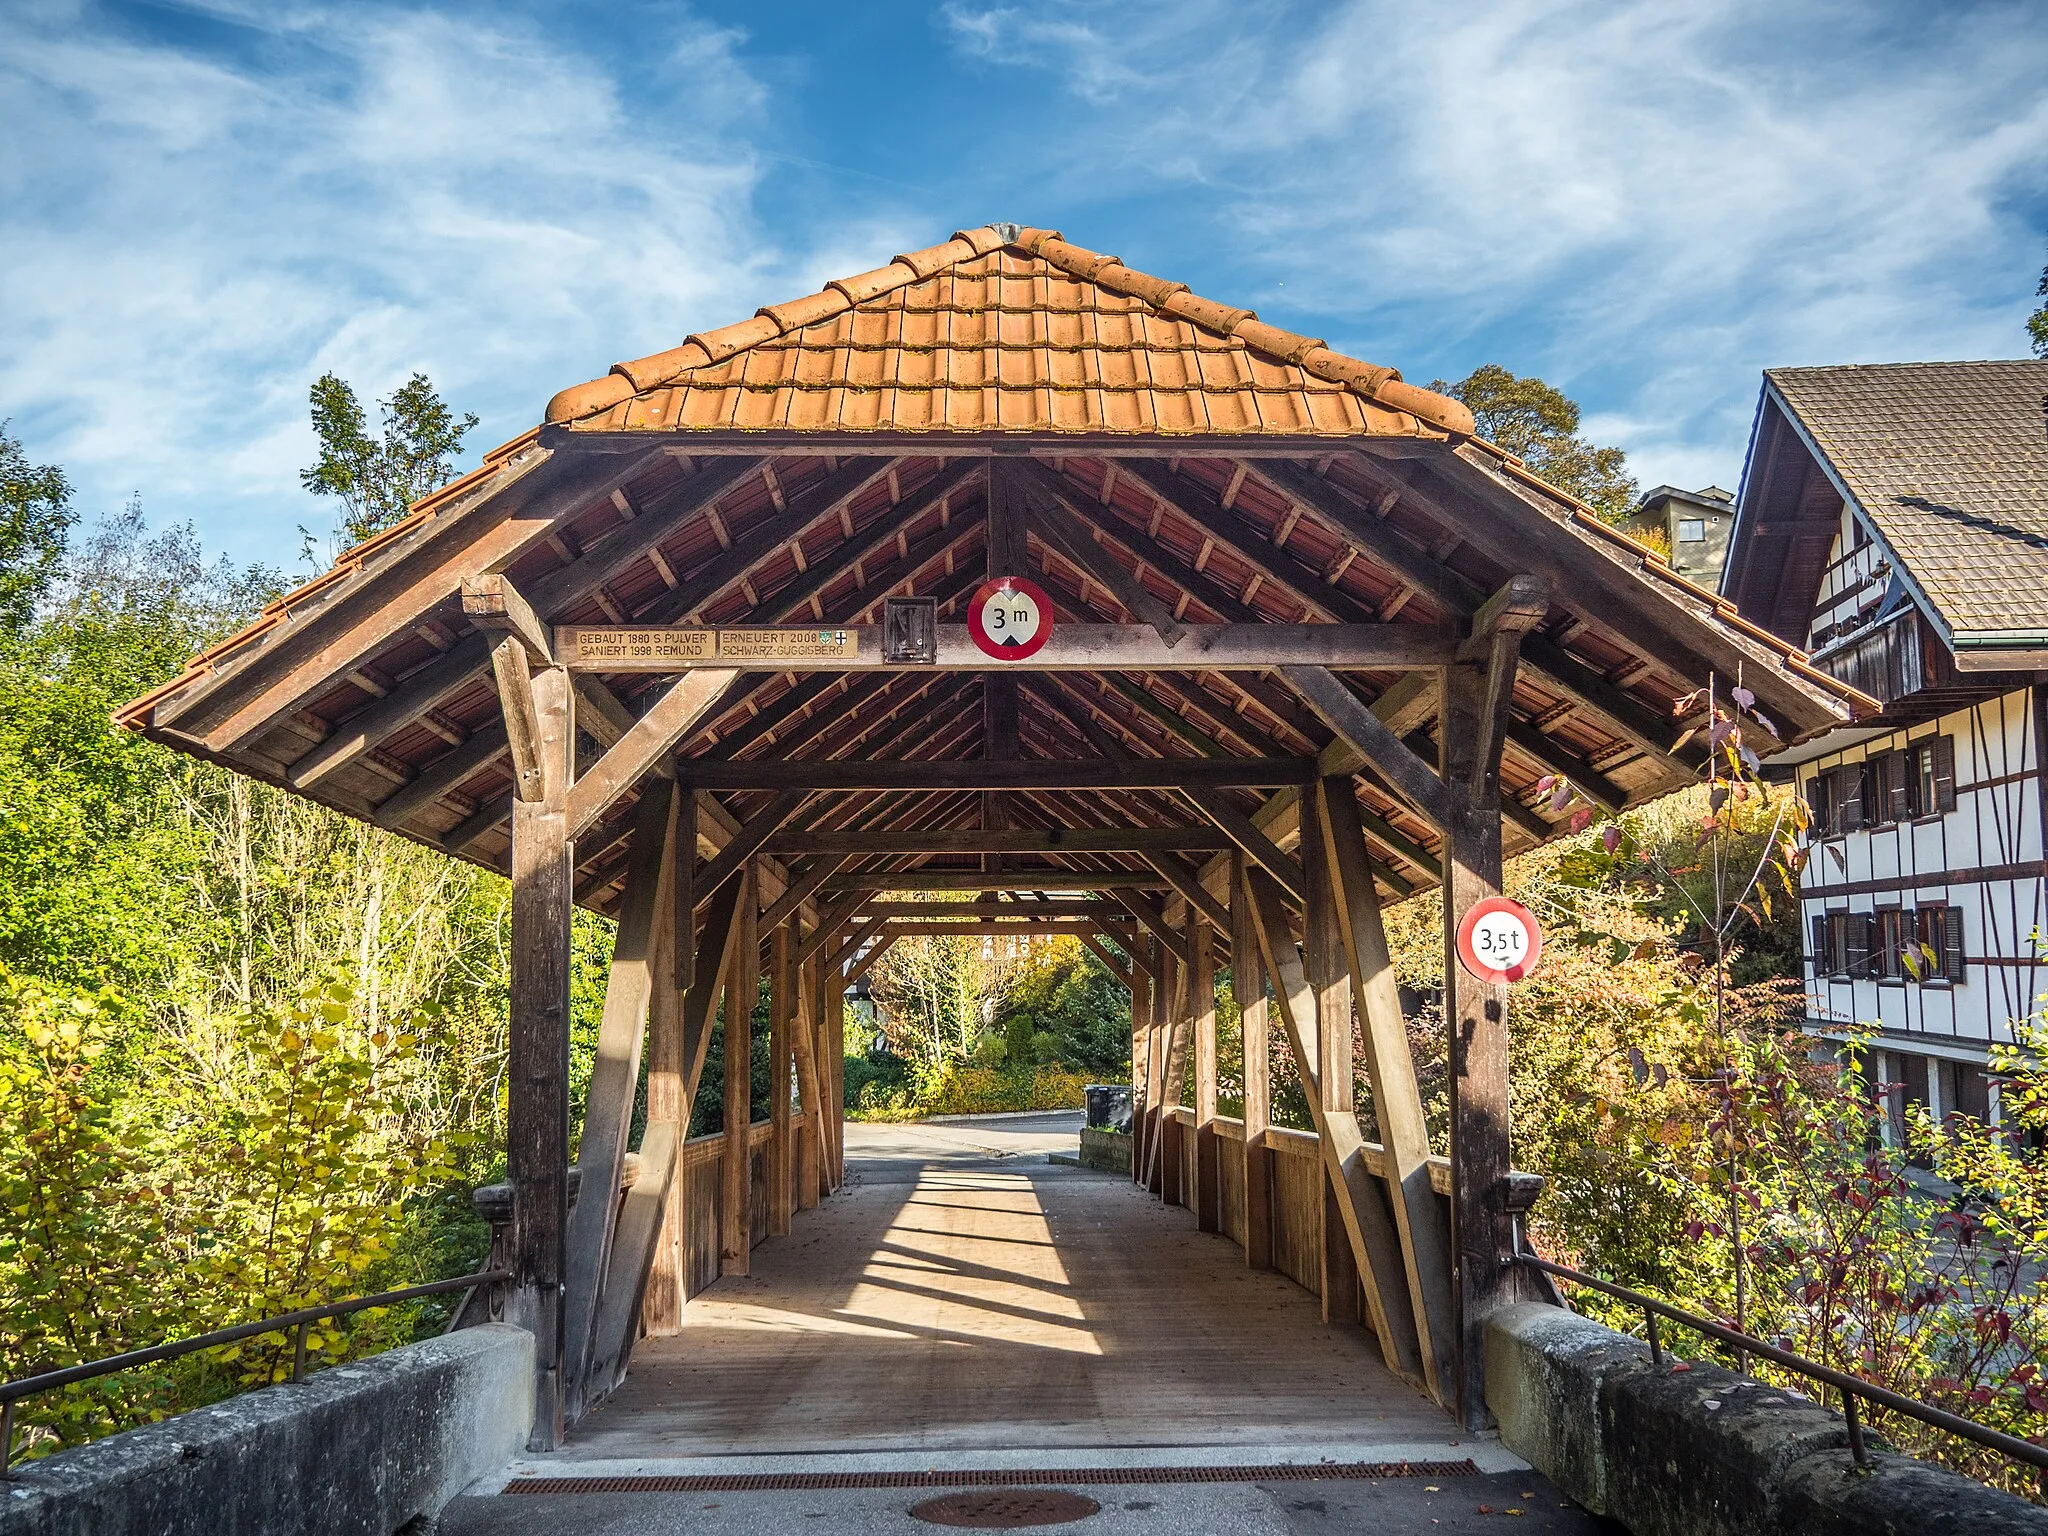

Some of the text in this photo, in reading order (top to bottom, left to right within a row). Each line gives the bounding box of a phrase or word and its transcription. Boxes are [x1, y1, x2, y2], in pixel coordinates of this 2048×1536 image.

[993, 608, 1028, 629] 3 m
[579, 634, 624, 644] GEBAUT
[628, 633, 650, 644] 1880
[665, 633, 708, 644] PULVER
[722, 633, 786, 643] ERNEUERT
[581, 645, 703, 656] SANIERT 1998 REMUND
[723, 645, 844, 656] SCHWARZ-GUGGISBERG
